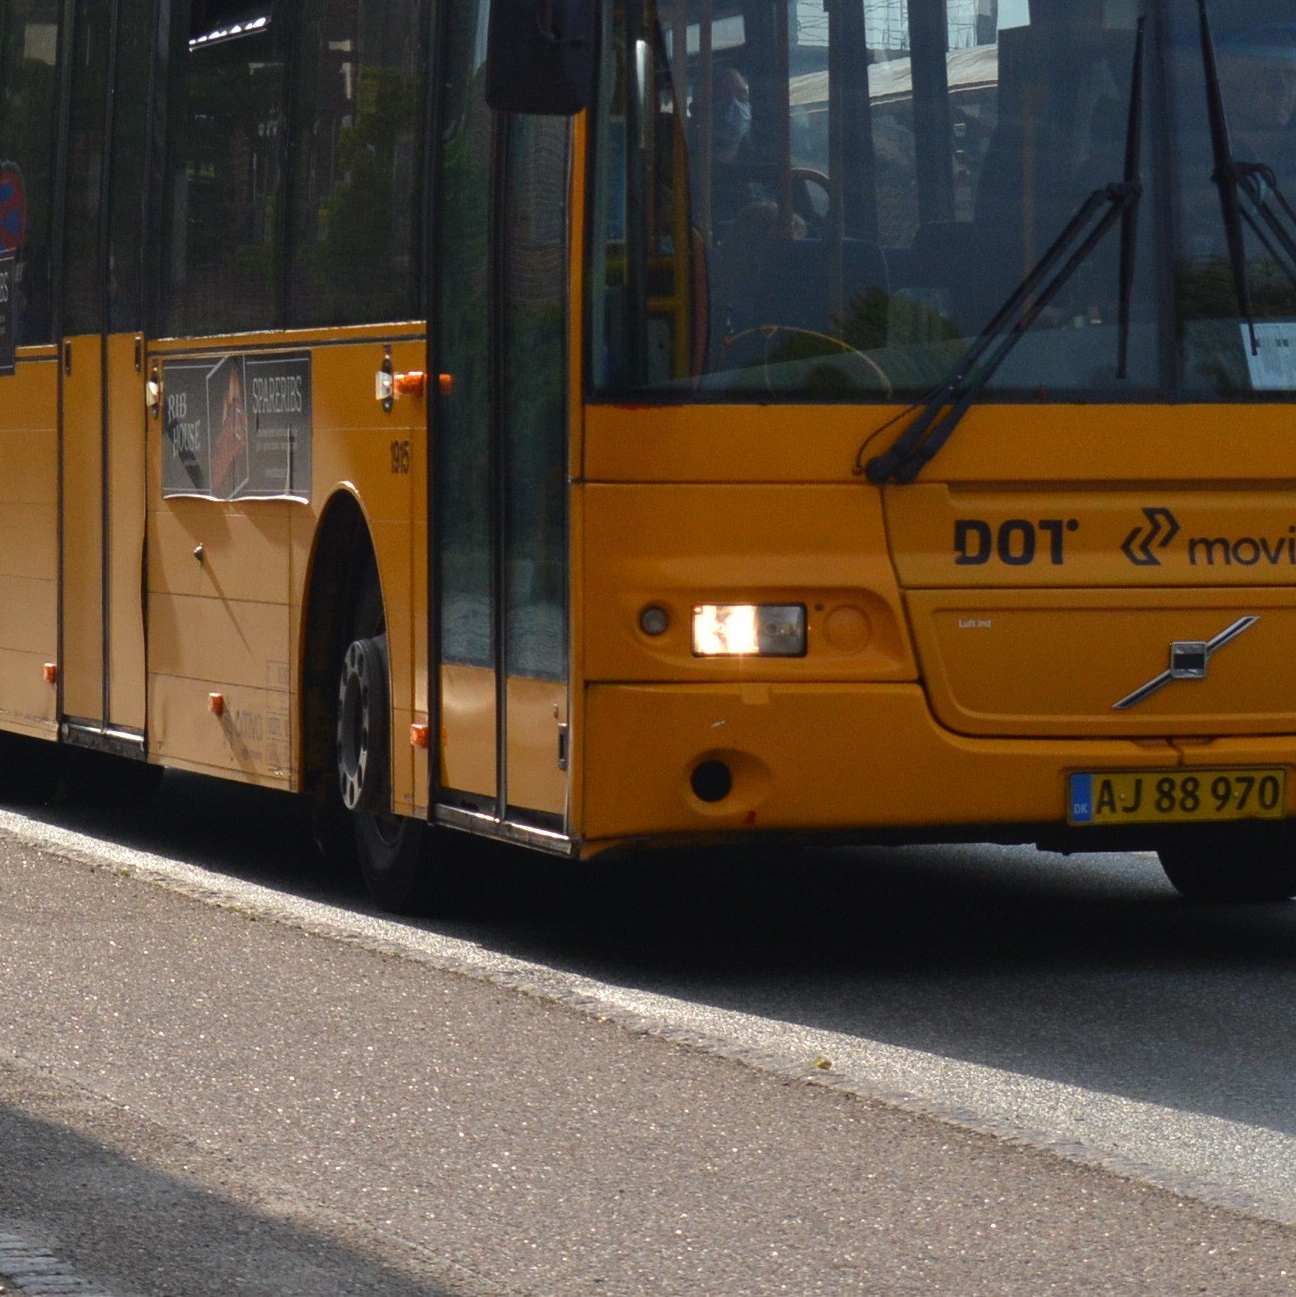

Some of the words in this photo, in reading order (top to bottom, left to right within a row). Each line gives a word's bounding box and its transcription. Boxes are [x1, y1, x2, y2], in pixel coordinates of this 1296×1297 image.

[168, 392, 188, 422] RIB
[252, 375, 303, 414] SPARERIBS
[173, 419, 202, 457] HOUSE
[390, 439, 410, 474] 1915
[1073, 803, 1089, 815] DK
[1096, 778, 1143, 815] AJ
[1155, 776, 1201, 814] 88
[1210, 774, 1280, 813] 970
